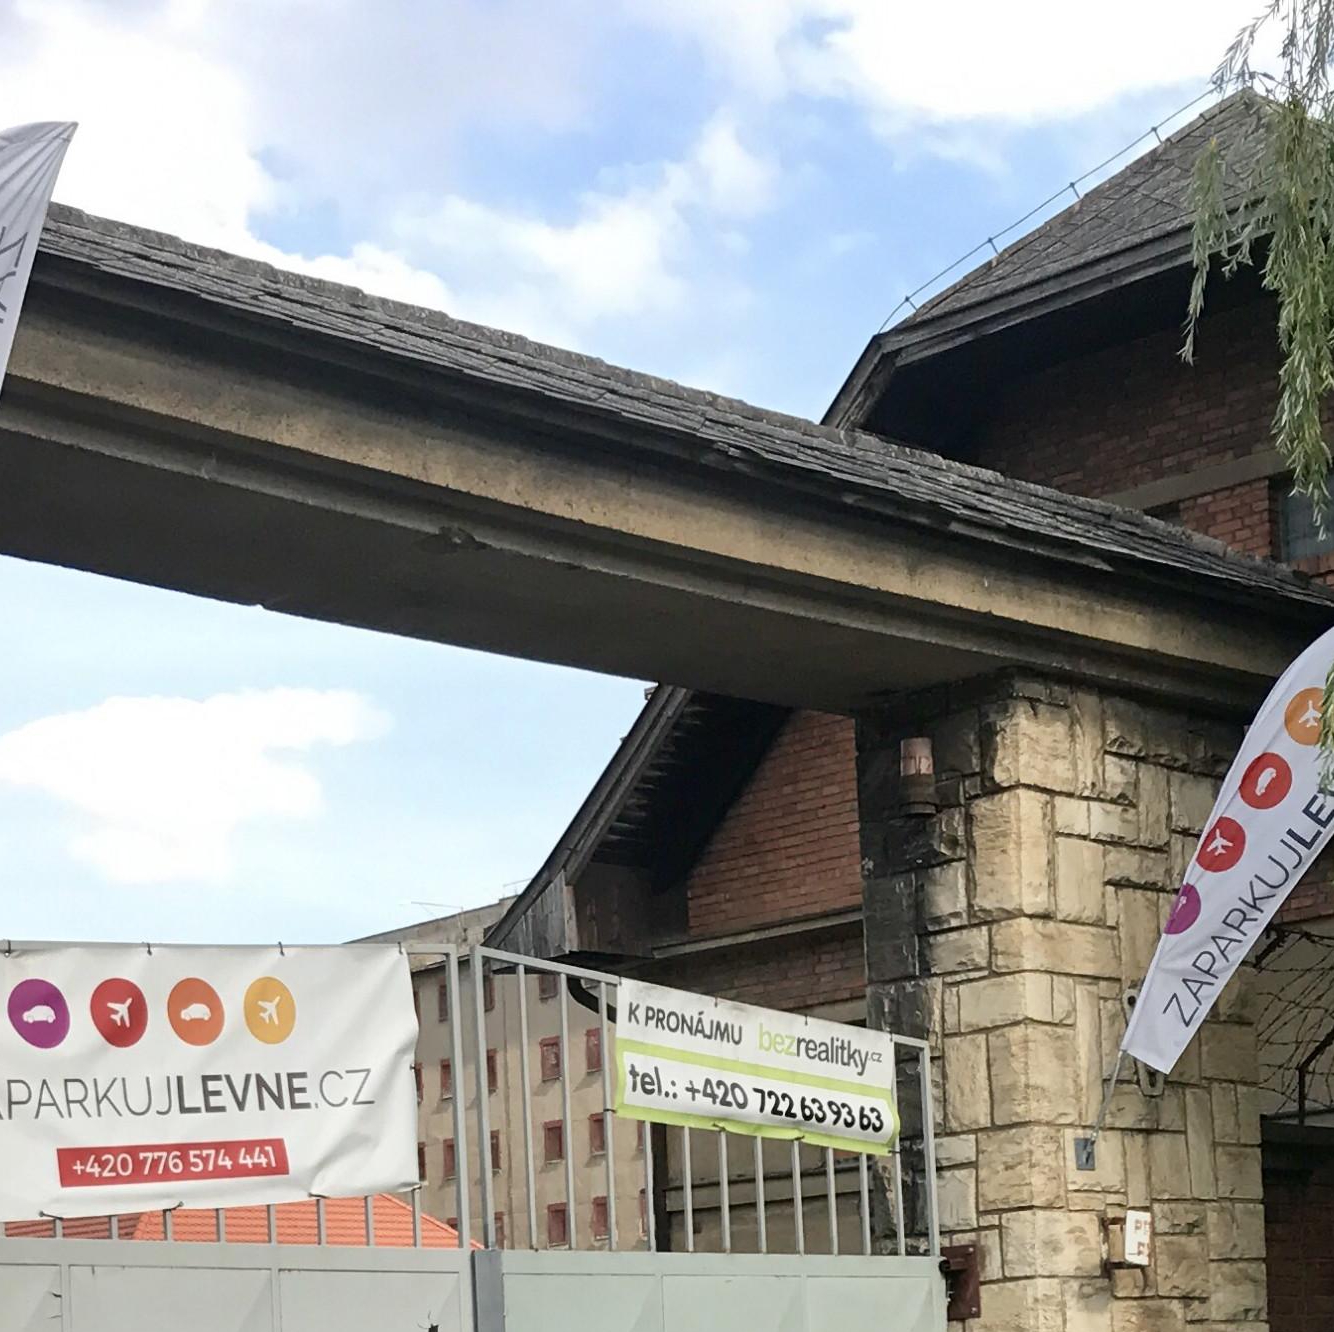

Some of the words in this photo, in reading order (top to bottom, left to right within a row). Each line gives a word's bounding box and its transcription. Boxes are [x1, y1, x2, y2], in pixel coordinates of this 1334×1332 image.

[628, 1001, 640, 1025] K
[644, 1006, 742, 1045] PRONÁJMU
[629, 1063, 679, 1099] tel.:
[685, 1079, 748, 1110] +420
[72, 1152, 133, 1177] +420
[140, 1149, 184, 1175] 776
[189, 1147, 233, 1172] 574
[238, 1145, 277, 1169] 441
